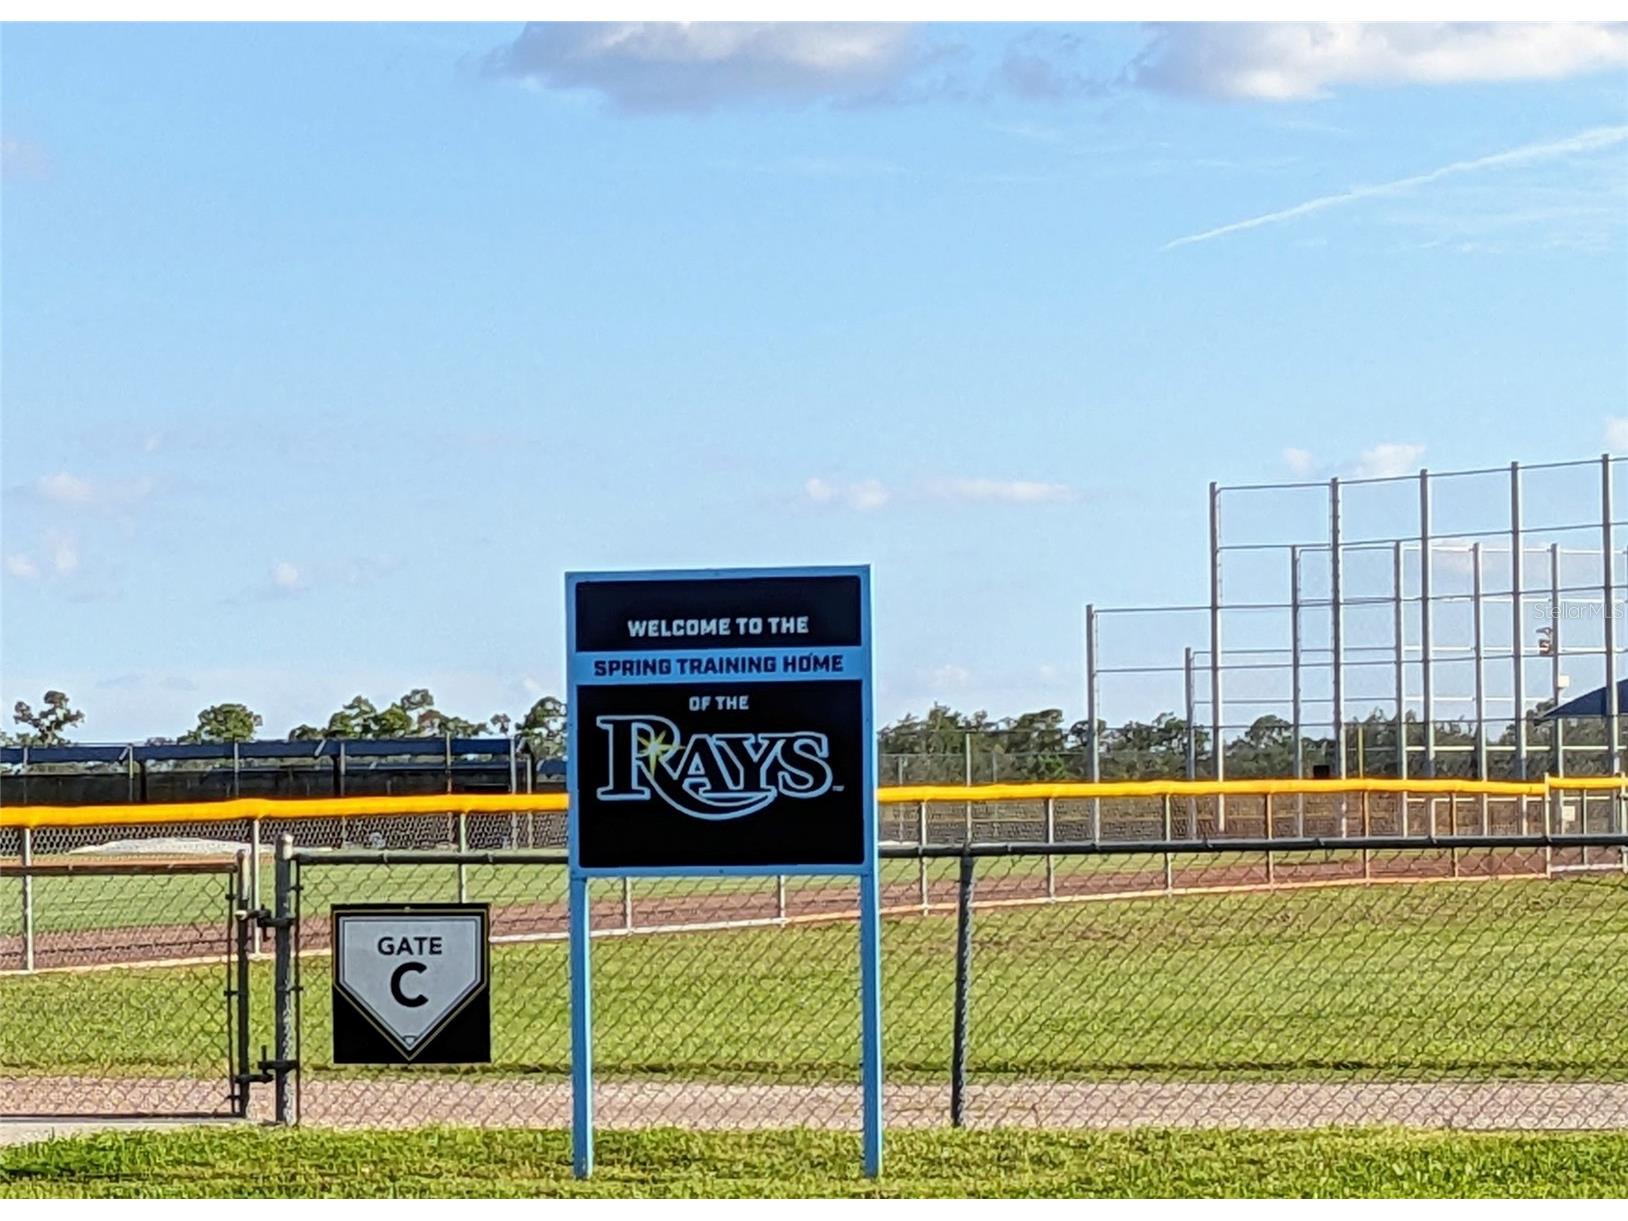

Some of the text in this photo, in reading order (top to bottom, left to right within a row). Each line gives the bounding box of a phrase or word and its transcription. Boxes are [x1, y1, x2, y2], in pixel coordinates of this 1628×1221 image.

[627, 616, 809, 637] WELCOME TO THE
[594, 654, 844, 677] SPRING TRAINING HOME
[689, 695, 749, 711] OF THE
[377, 936, 443, 956] GATE
[390, 961, 429, 1008] C
